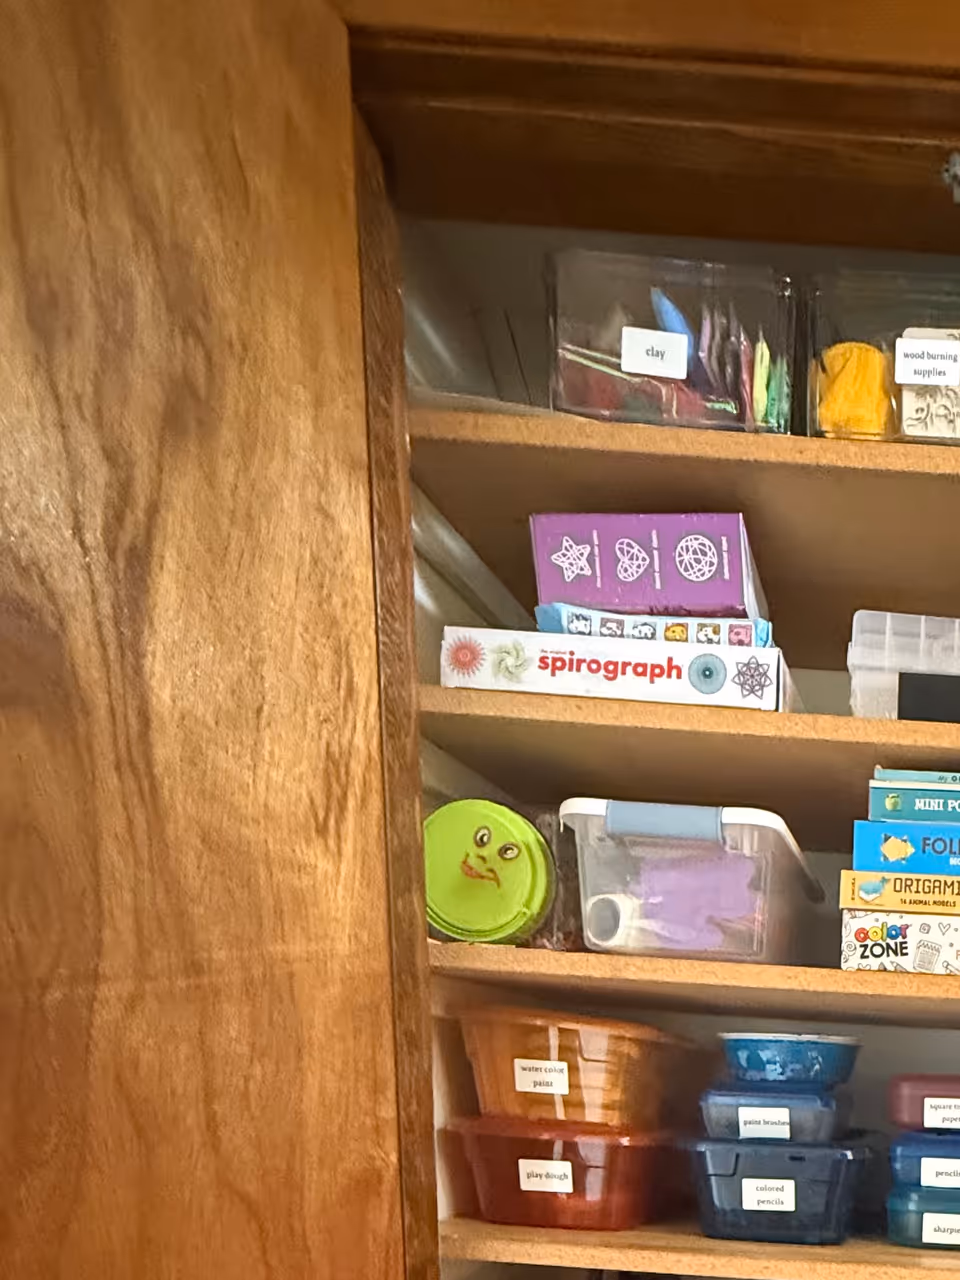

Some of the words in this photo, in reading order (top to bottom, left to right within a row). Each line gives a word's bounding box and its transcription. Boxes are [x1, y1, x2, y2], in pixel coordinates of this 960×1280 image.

[645, 345, 666, 360] clay
[903, 350, 925, 360] wood
[926, 351, 958, 363] burning
[913, 367, 947, 379] supplies
[538, 650, 682, 684] spirograph
[914, 798, 944, 811] MINI
[908, 899, 931, 907] ANIMAL
[932, 900, 957, 908] MODELS
[854, 921, 910, 942] color
[859, 941, 909, 959] ZONE
[520, 1065, 543, 1073] water
[544, 1066, 565, 1074] color
[533, 1080, 554, 1088] paint
[743, 1119, 762, 1127] paint
[526, 1170, 543, 1180] play
[544, 1172, 569, 1181] dough
[755, 1184, 785, 1192] colored
[757, 1198, 785, 1206] pencils
